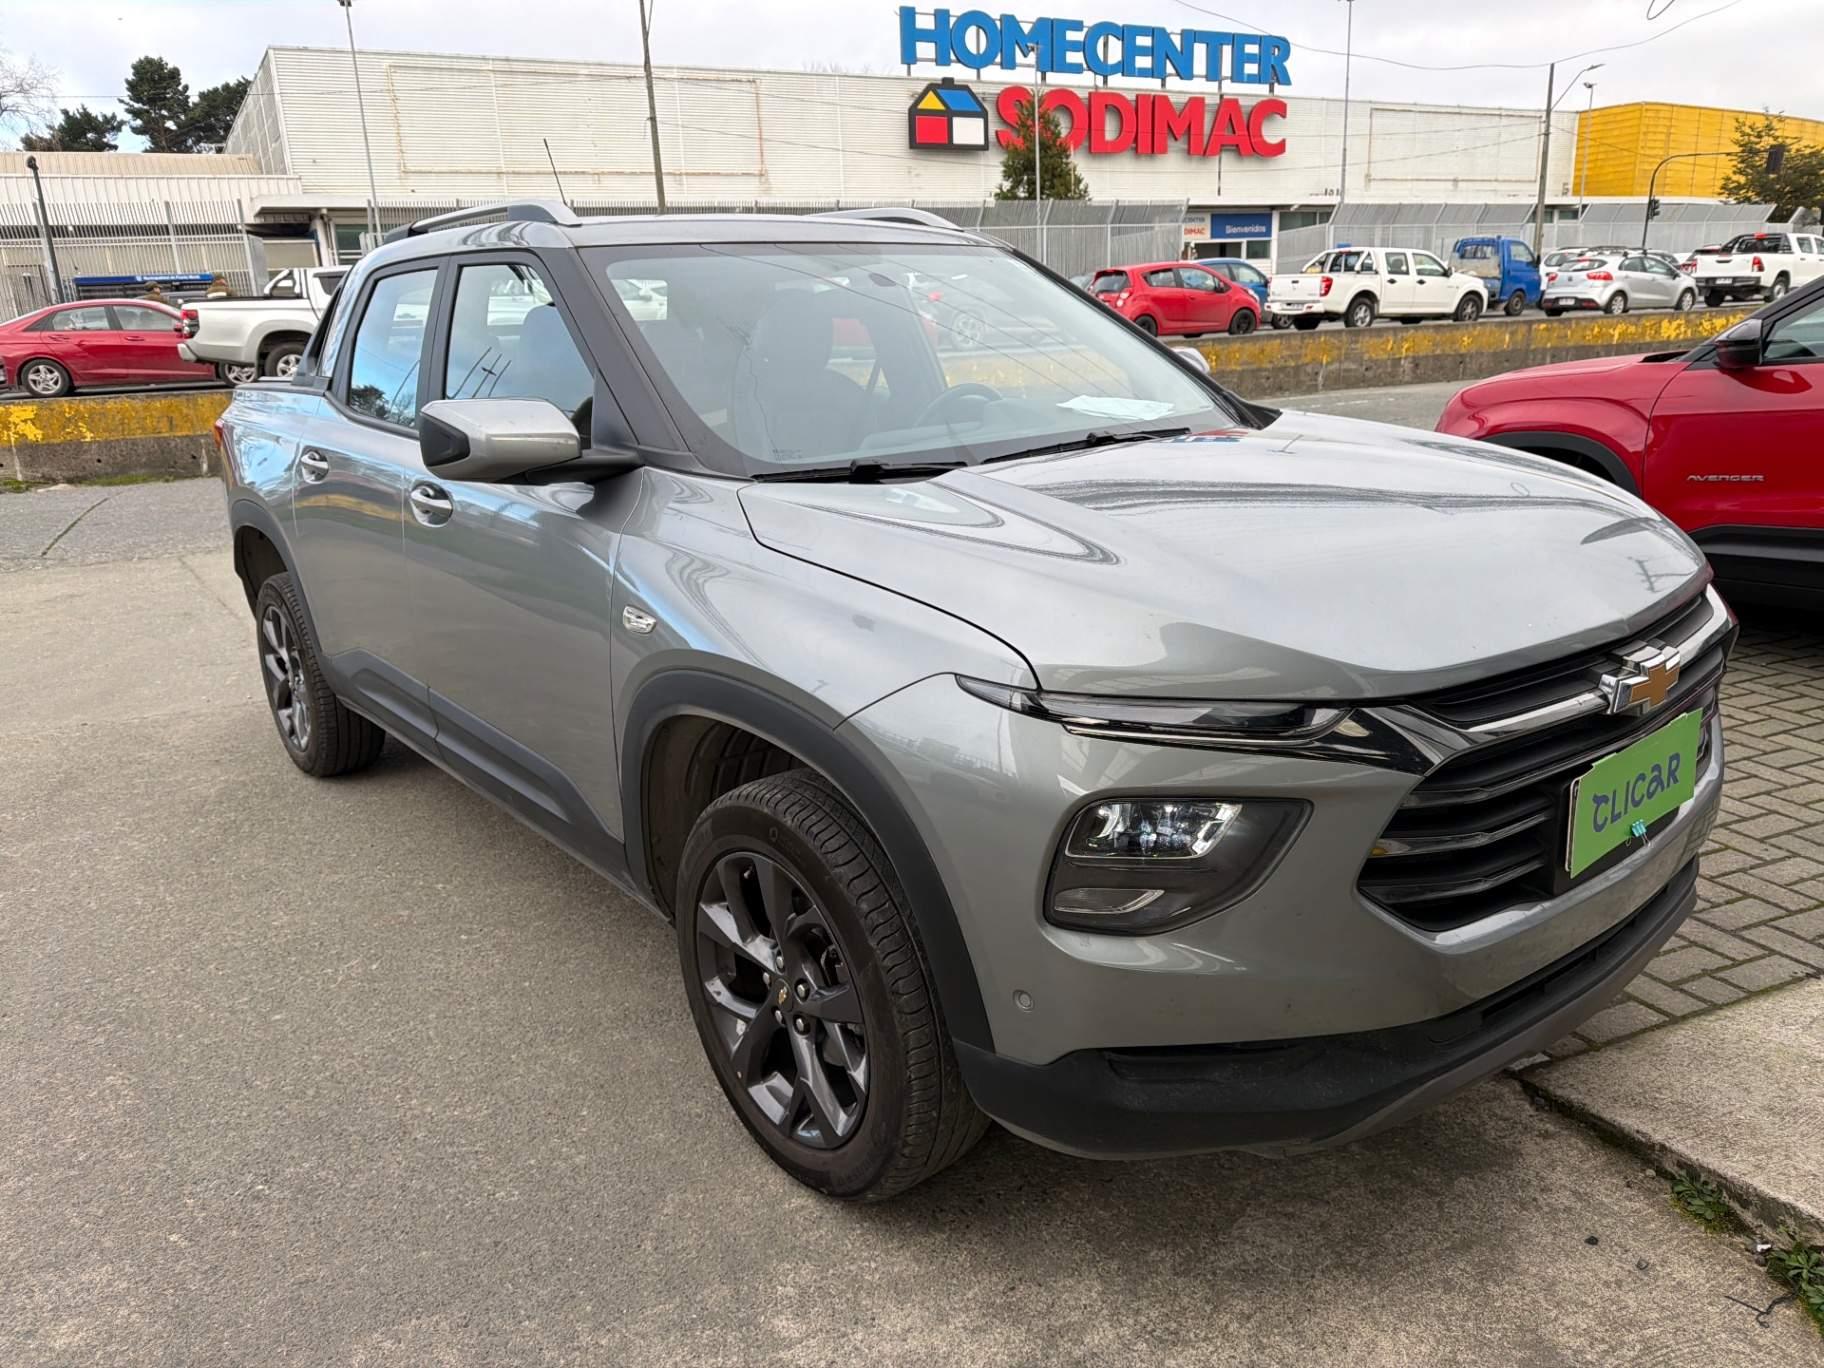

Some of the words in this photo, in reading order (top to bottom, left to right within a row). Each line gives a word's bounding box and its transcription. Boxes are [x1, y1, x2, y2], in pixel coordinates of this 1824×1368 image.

[899, 6, 1292, 86] HOMECENTER
[995, 85, 1288, 158] SODIMAC
[1225, 223, 1266, 234] Bienvenidos
[1686, 474, 1765, 482] AVENGER
